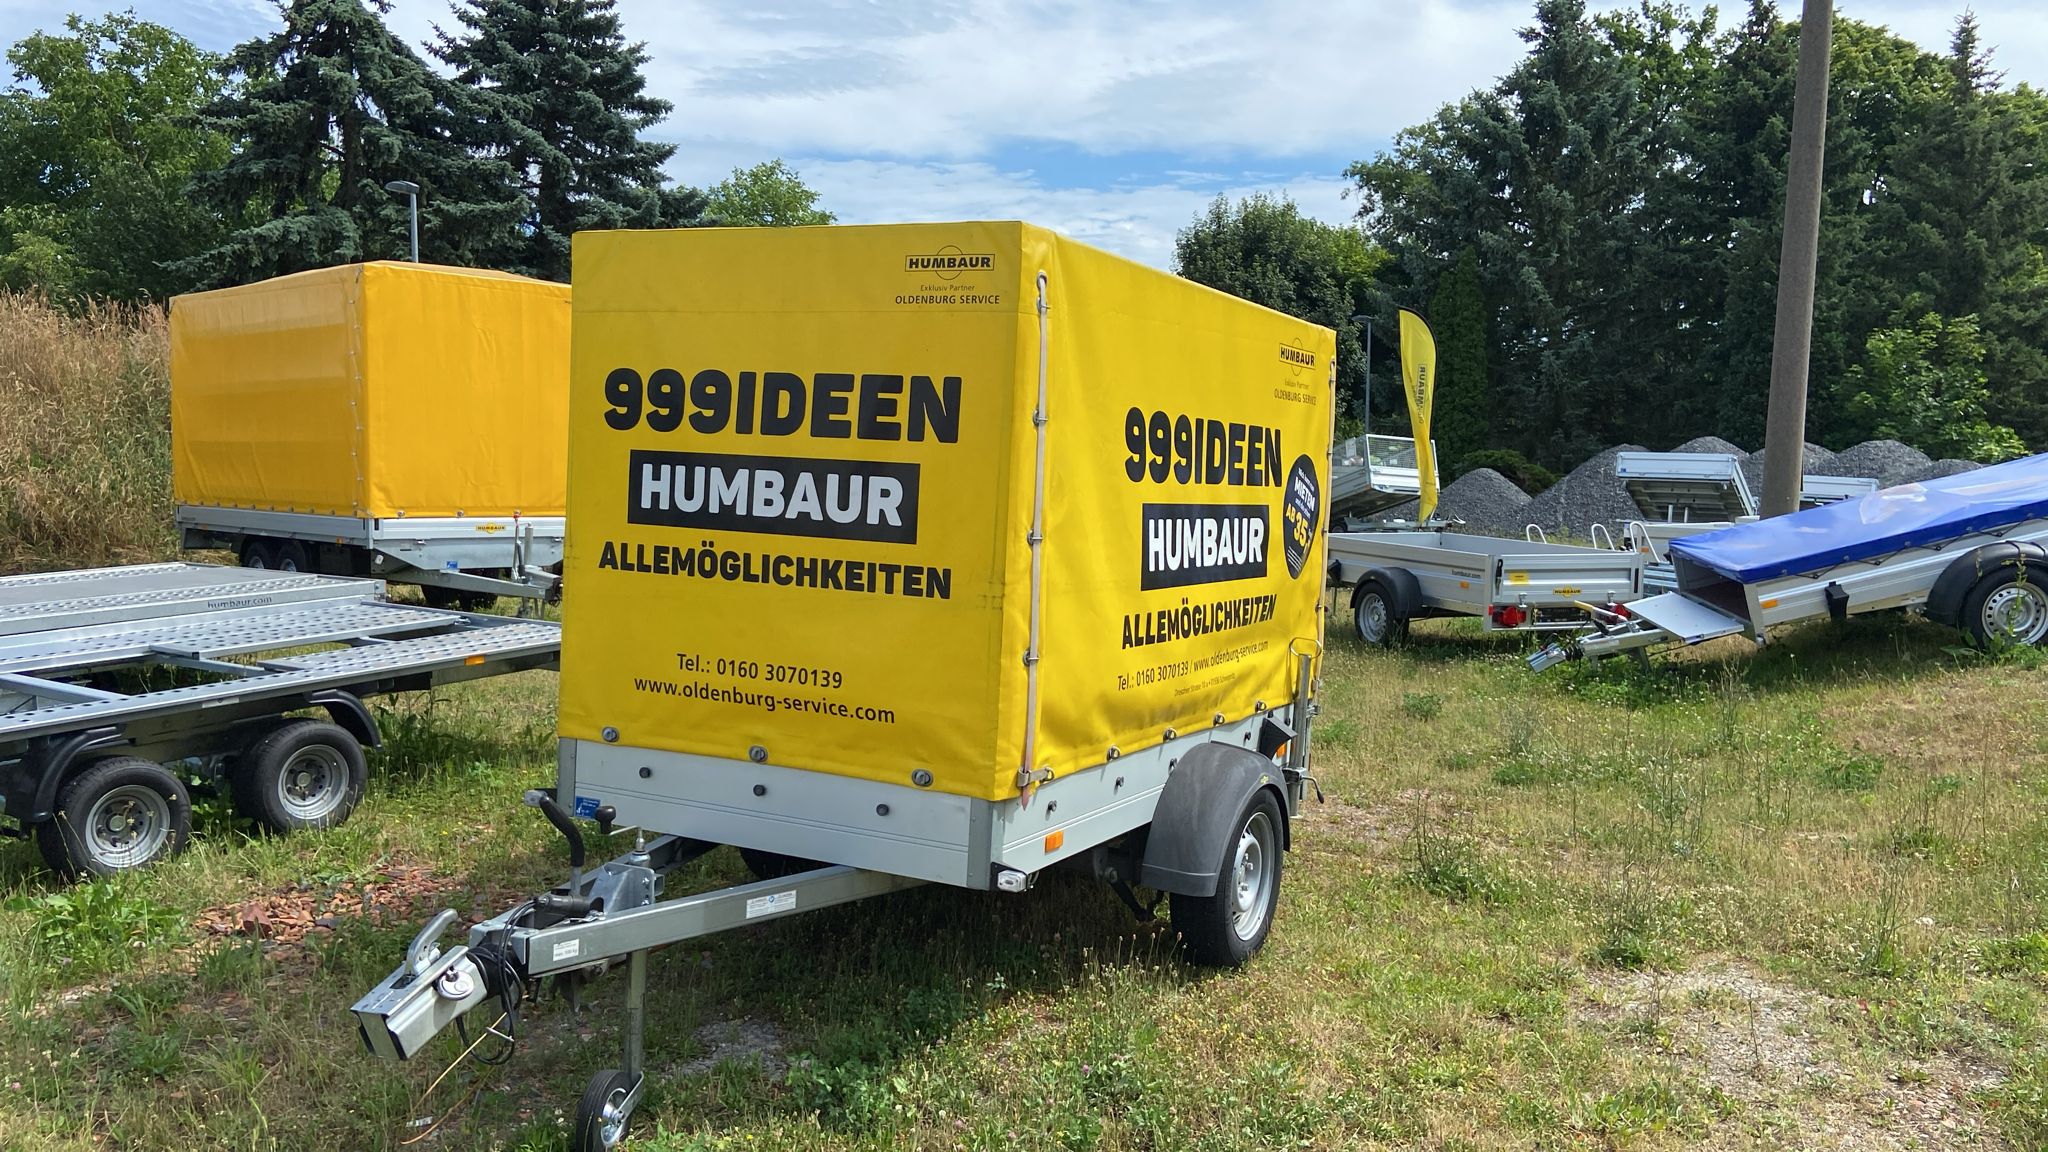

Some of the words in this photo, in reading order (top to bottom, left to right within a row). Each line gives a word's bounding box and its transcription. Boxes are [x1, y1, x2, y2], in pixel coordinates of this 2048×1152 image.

[908, 257, 991, 269] HUMBAUR
[895, 295, 956, 304] OLDENBURG
[959, 295, 1000, 304] SERVICE
[920, 284, 947, 292] Exklusiv
[949, 284, 975, 292] Partner
[1280, 347, 1315, 366] HUMBAUR
[603, 367, 962, 443] 999IDEEN
[1125, 407, 1282, 487] 999IDEEN
[640, 463, 904, 527] HUMBAUR
[1148, 517, 1265, 572] HUMBAUR
[598, 540, 952, 599] ALLEMÖGLICHKEITEN
[207, 597, 272, 608] humbaur.com
[1122, 594, 1277, 649] ALLEMÖGLICHKEITEN
[676, 653, 711, 674] Tel.:
[716, 658, 759, 681] 0160
[764, 663, 843, 689] 3070139
[1118, 674, 1134, 691] Tel.:
[1136, 668, 1155, 687] 0160
[1157, 660, 1189, 682] 3070139
[634, 676, 895, 724] www.oldenburg-service.com
